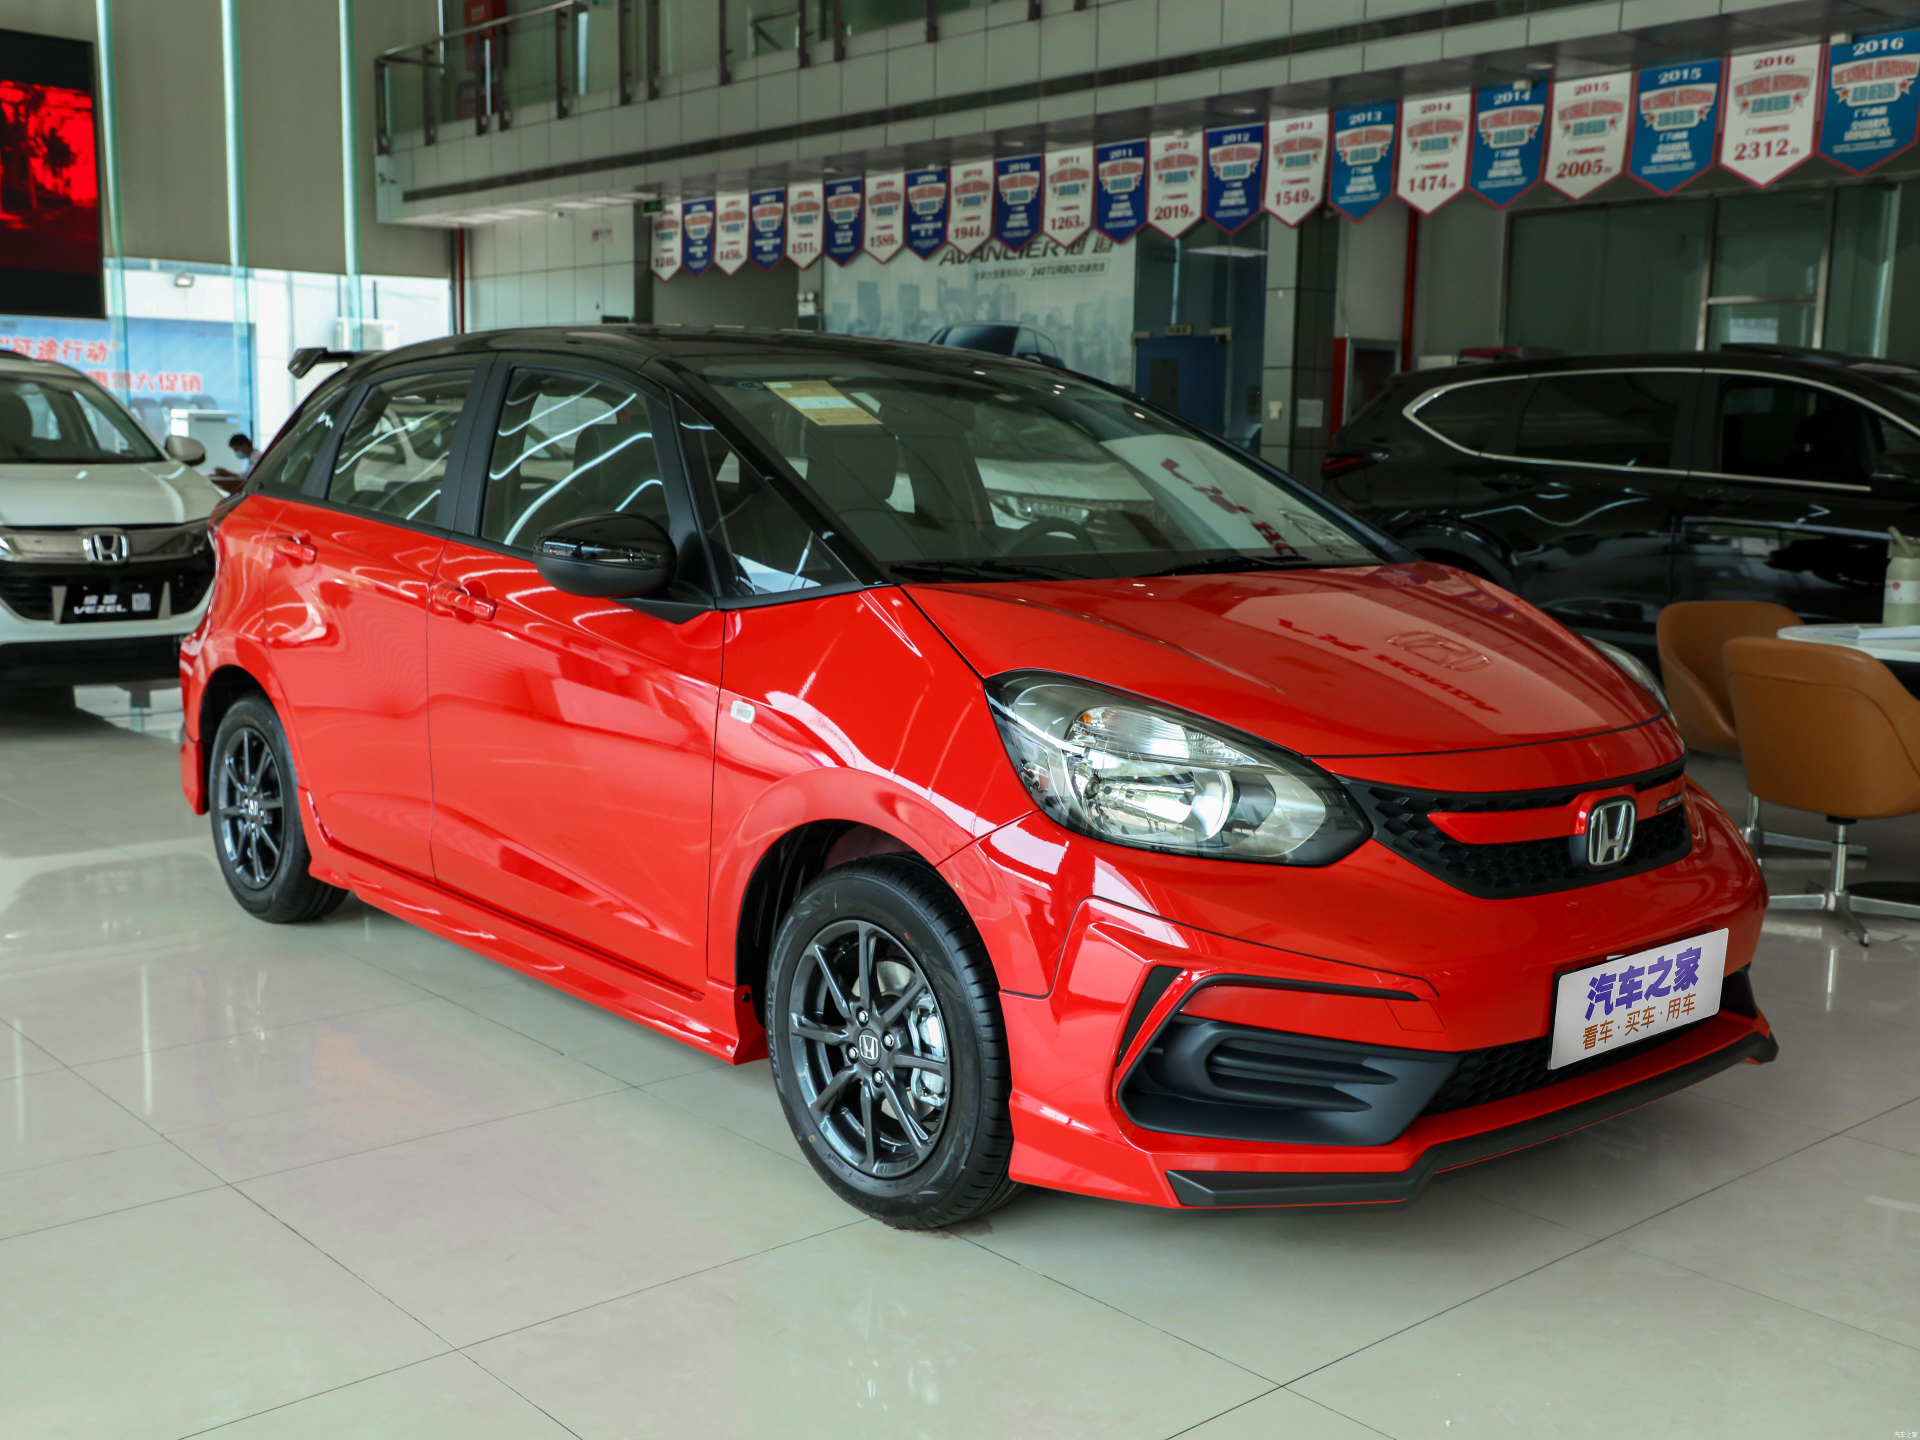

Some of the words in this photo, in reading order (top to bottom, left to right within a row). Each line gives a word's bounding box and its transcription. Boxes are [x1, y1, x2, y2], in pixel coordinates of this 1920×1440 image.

[1853, 37, 1905, 56] 2016
[1753, 54, 1796, 70] 2016
[1658, 67, 1702, 85] 2015
[1573, 82, 1610, 96] 2015
[1493, 90, 1531, 106] 2014
[1420, 103, 1452, 115] 2014
[1349, 111, 1382, 125] 2013
[1286, 121, 1313, 133] 2013
[1221, 132, 1250, 145] 2012
[1109, 148, 1133, 160] 2011
[1164, 141, 1190, 152] 2012
[1734, 138, 1790, 161] 2312
[1058, 156, 1080, 166] 2011
[1556, 159, 1604, 180] 2005
[1408, 174, 1448, 192] 1474
[1274, 189, 1311, 206] 1549
[1154, 204, 1190, 221] 2019
[1051, 214, 1081, 231] 1263
[954, 225, 981, 240] 1944
[792, 241, 814, 255] 1511
[870, 233, 895, 248] 1589
[73, 603, 128, 615] VEZEL
[1585, 946, 1702, 1021] 汽车之家
